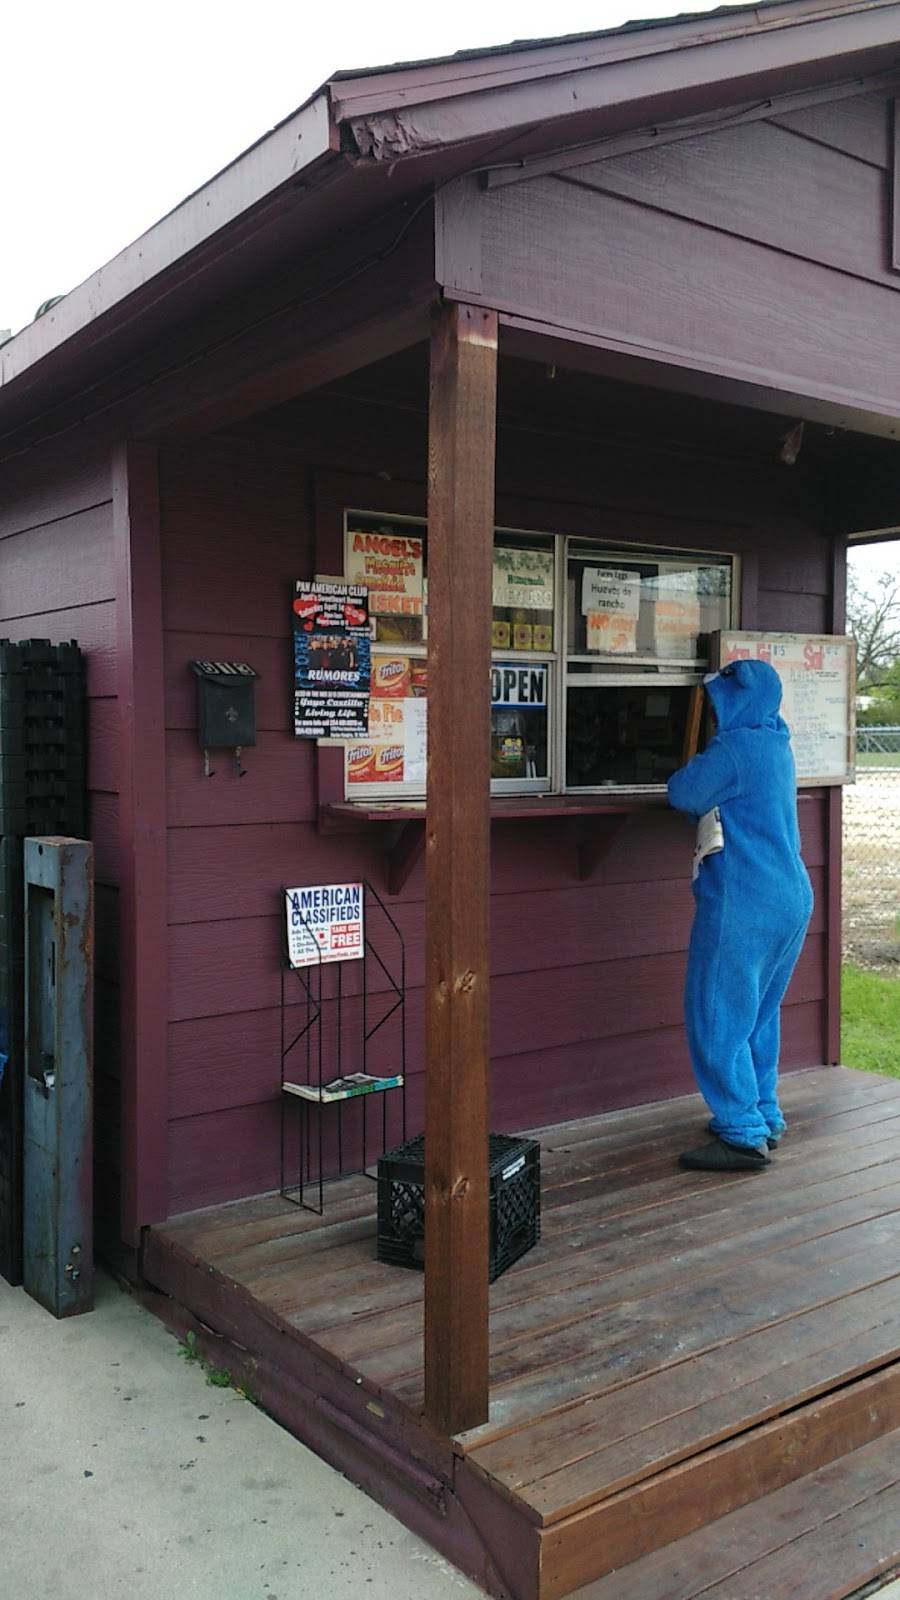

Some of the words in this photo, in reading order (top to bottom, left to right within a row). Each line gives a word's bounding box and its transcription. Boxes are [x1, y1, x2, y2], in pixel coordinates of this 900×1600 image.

[296, 580, 310, 592] PAN
[311, 583, 347, 595] AMERICAN
[348, 586, 368, 597] CLUB
[369, 594, 422, 613] ISKET
[598, 599, 626, 609] rancho
[308, 669, 361, 682] RUMORES
[491, 669, 543, 703] OPEN
[326, 698, 364, 708] Castillo
[305, 708, 336, 718] Living
[337, 709, 357, 718] Life
[292, 886, 360, 910] AMERICAN
[291, 904, 360, 927] CLASSIFIEDS
[331, 931, 360, 949] FREE
